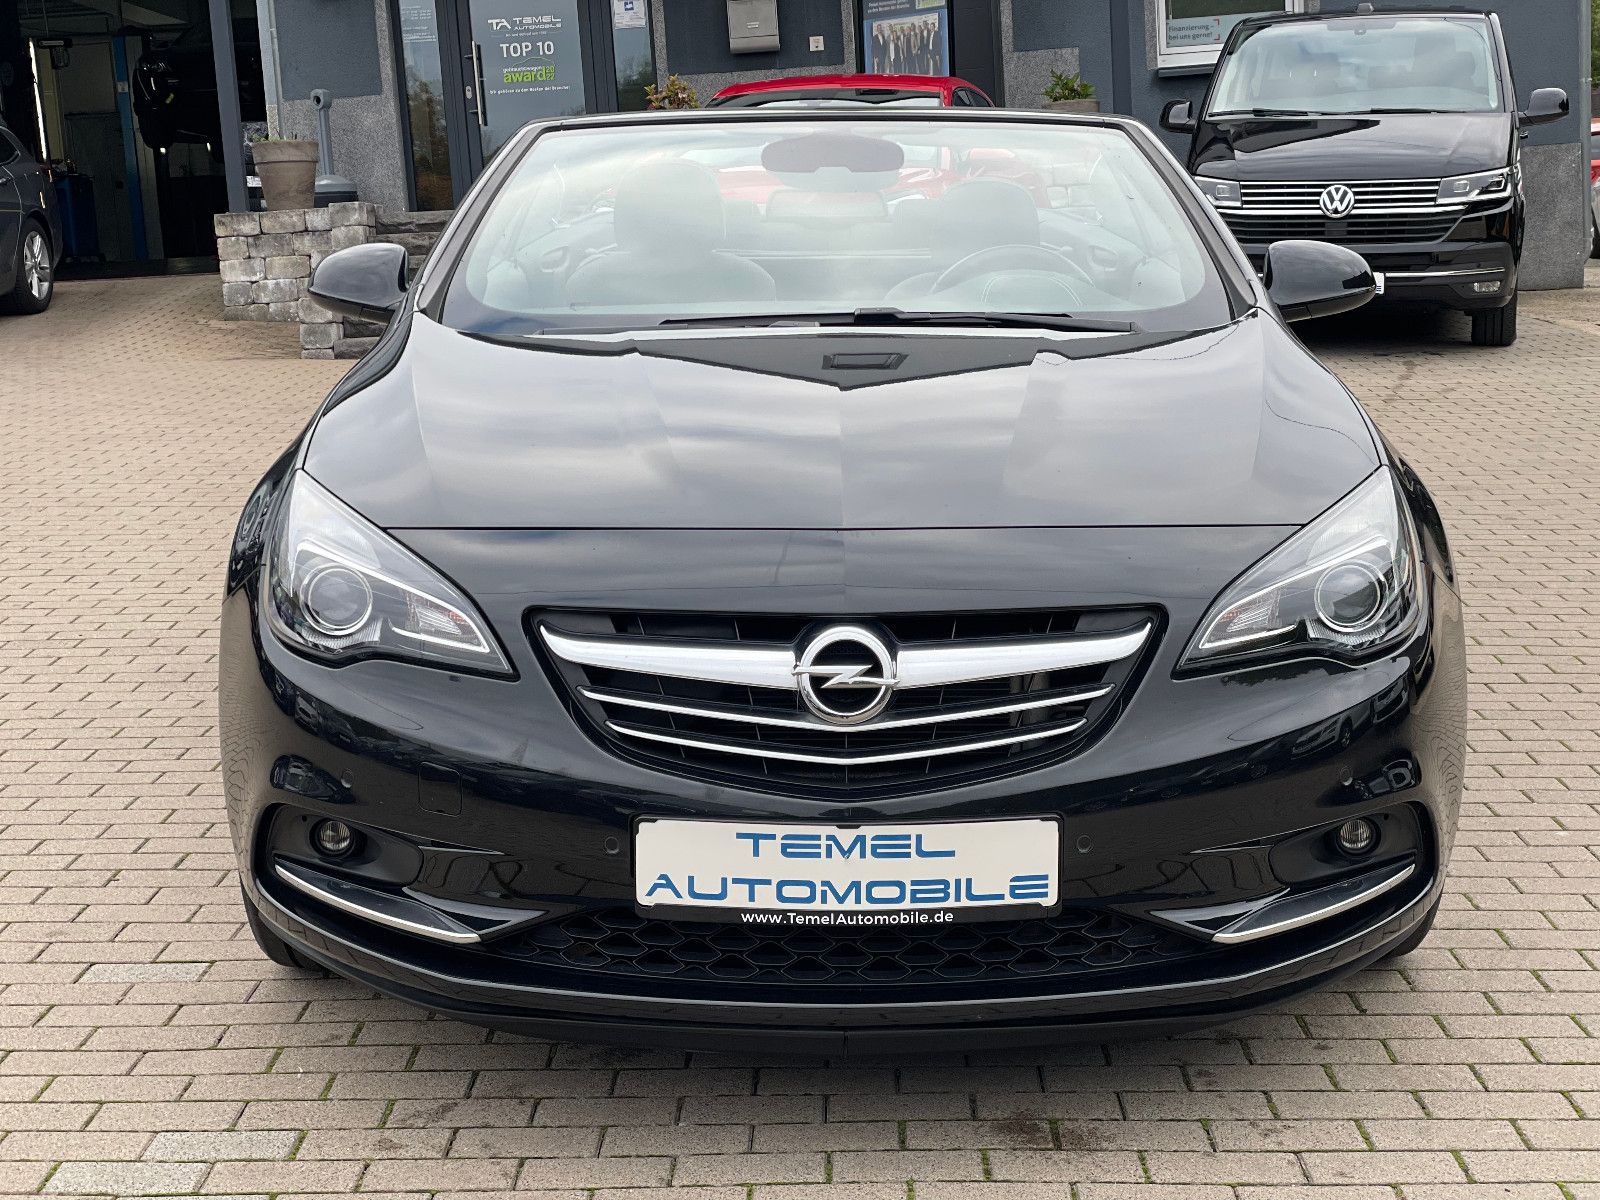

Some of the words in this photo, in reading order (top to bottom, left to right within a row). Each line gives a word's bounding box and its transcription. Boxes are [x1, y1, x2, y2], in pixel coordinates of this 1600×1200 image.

[488, 19, 511, 30] TA
[513, 15, 561, 24] TEMEL
[1168, 24, 1210, 33] Finanzierung
[1192, 32, 1213, 40] gerne!
[500, 42, 532, 58] TOP
[537, 41, 554, 55] 10
[504, 65, 546, 83] award
[736, 832, 956, 859] TEMEL
[645, 873, 1049, 906] AUTOMOBILE
[741, 911, 954, 925] www.TemelAutomobile.de
